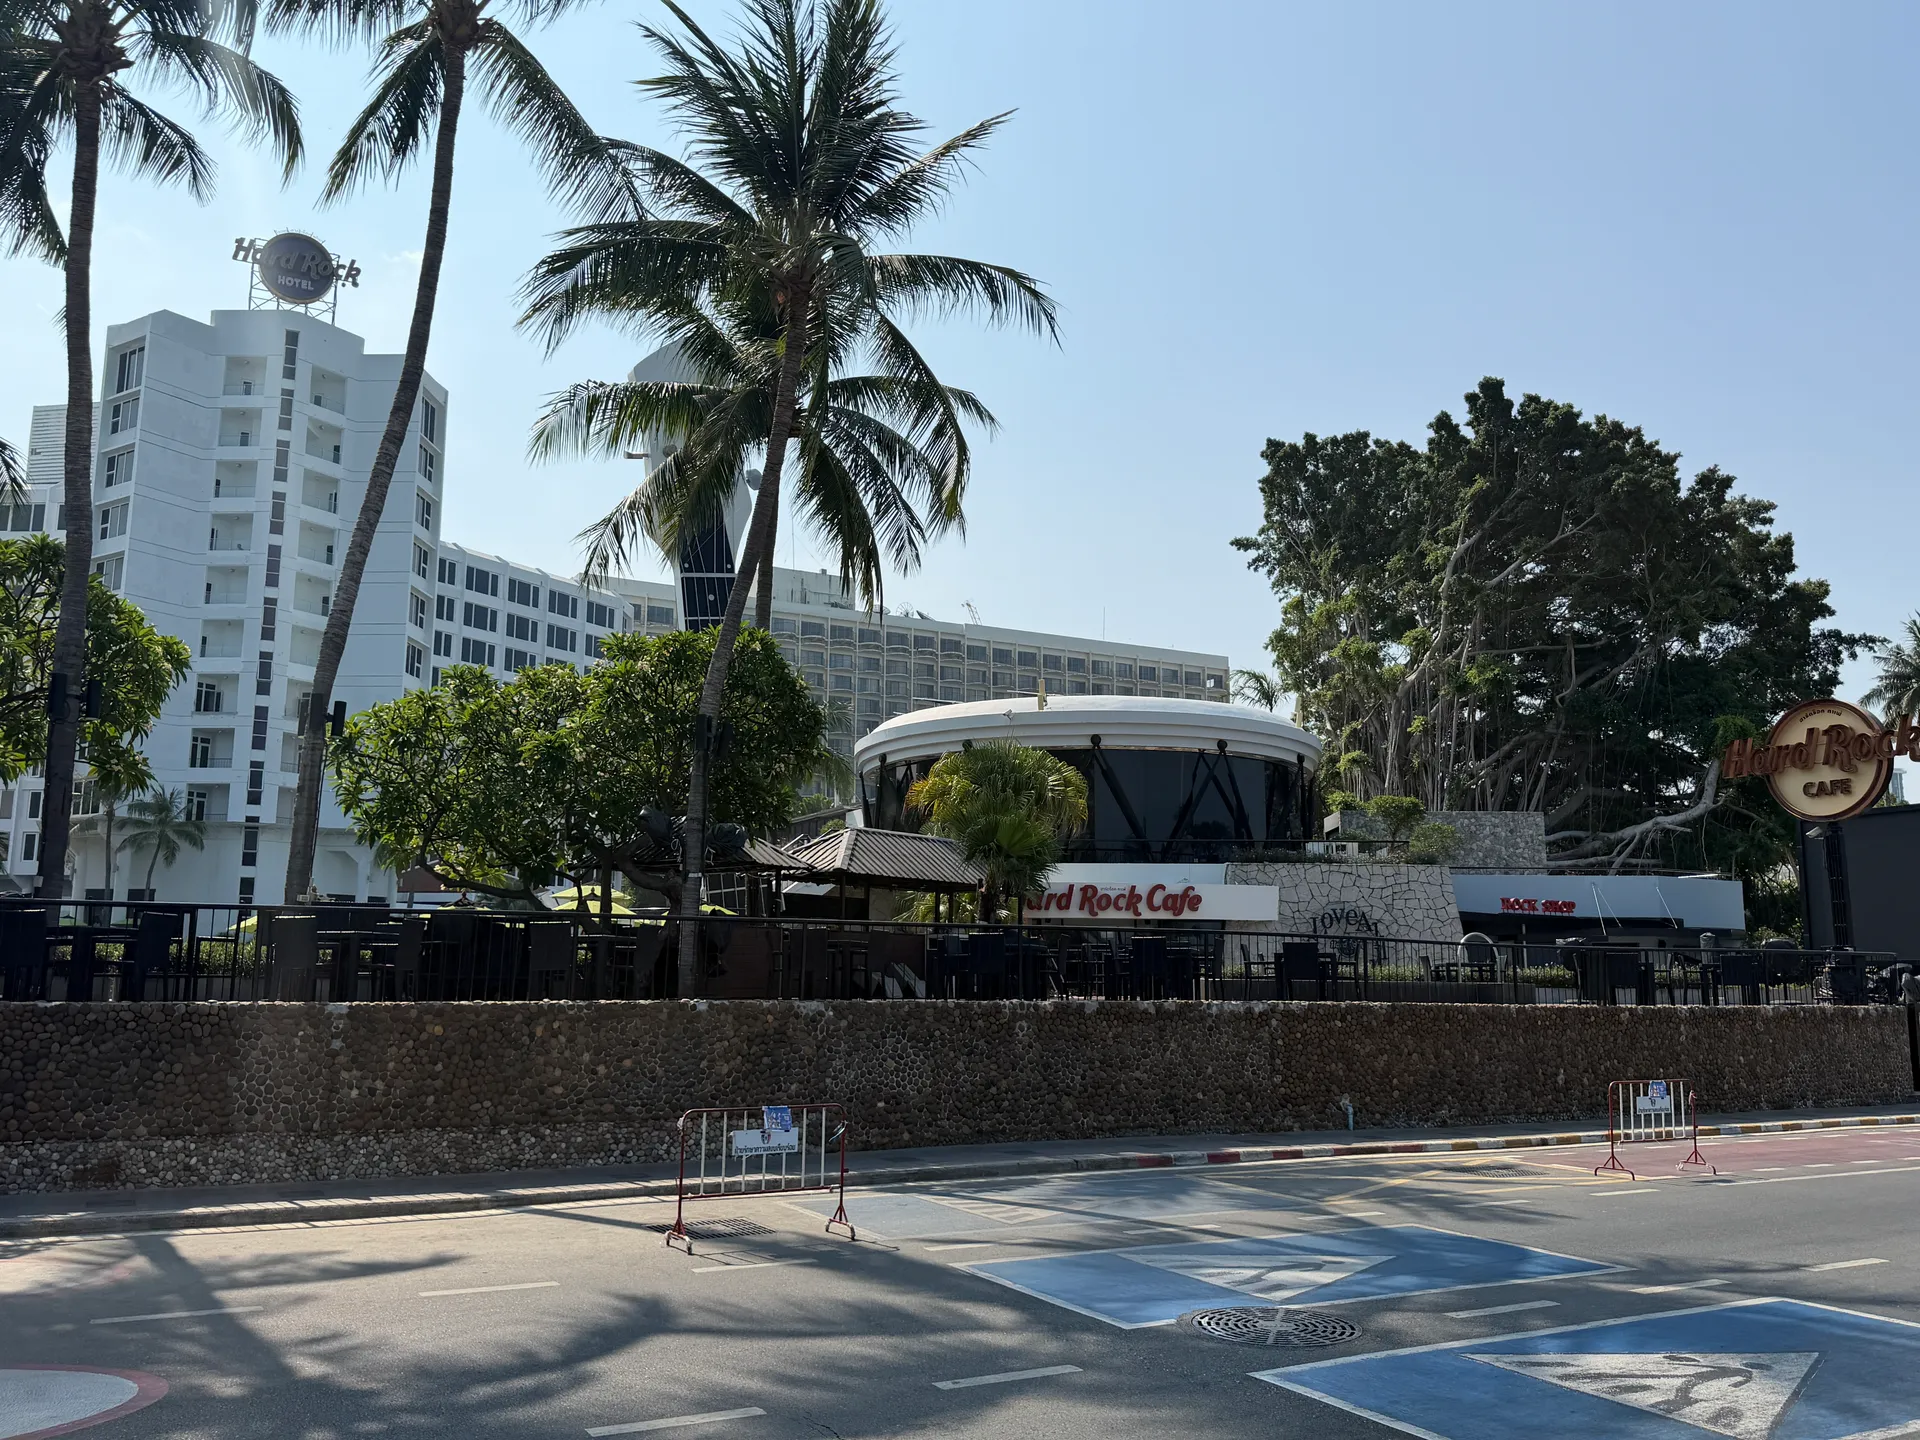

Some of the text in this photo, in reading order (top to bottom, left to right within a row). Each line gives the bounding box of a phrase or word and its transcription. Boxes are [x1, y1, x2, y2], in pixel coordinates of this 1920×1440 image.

[232, 237, 361, 288] Hard Rock
[278, 275, 314, 290] HOTEL
[1722, 713, 1920, 779] Hard Rock
[1803, 778, 1852, 798] CAFE
[1026, 883, 1203, 917] ard Rock Cafe
[1500, 897, 1576, 913] ROCK SHOP
